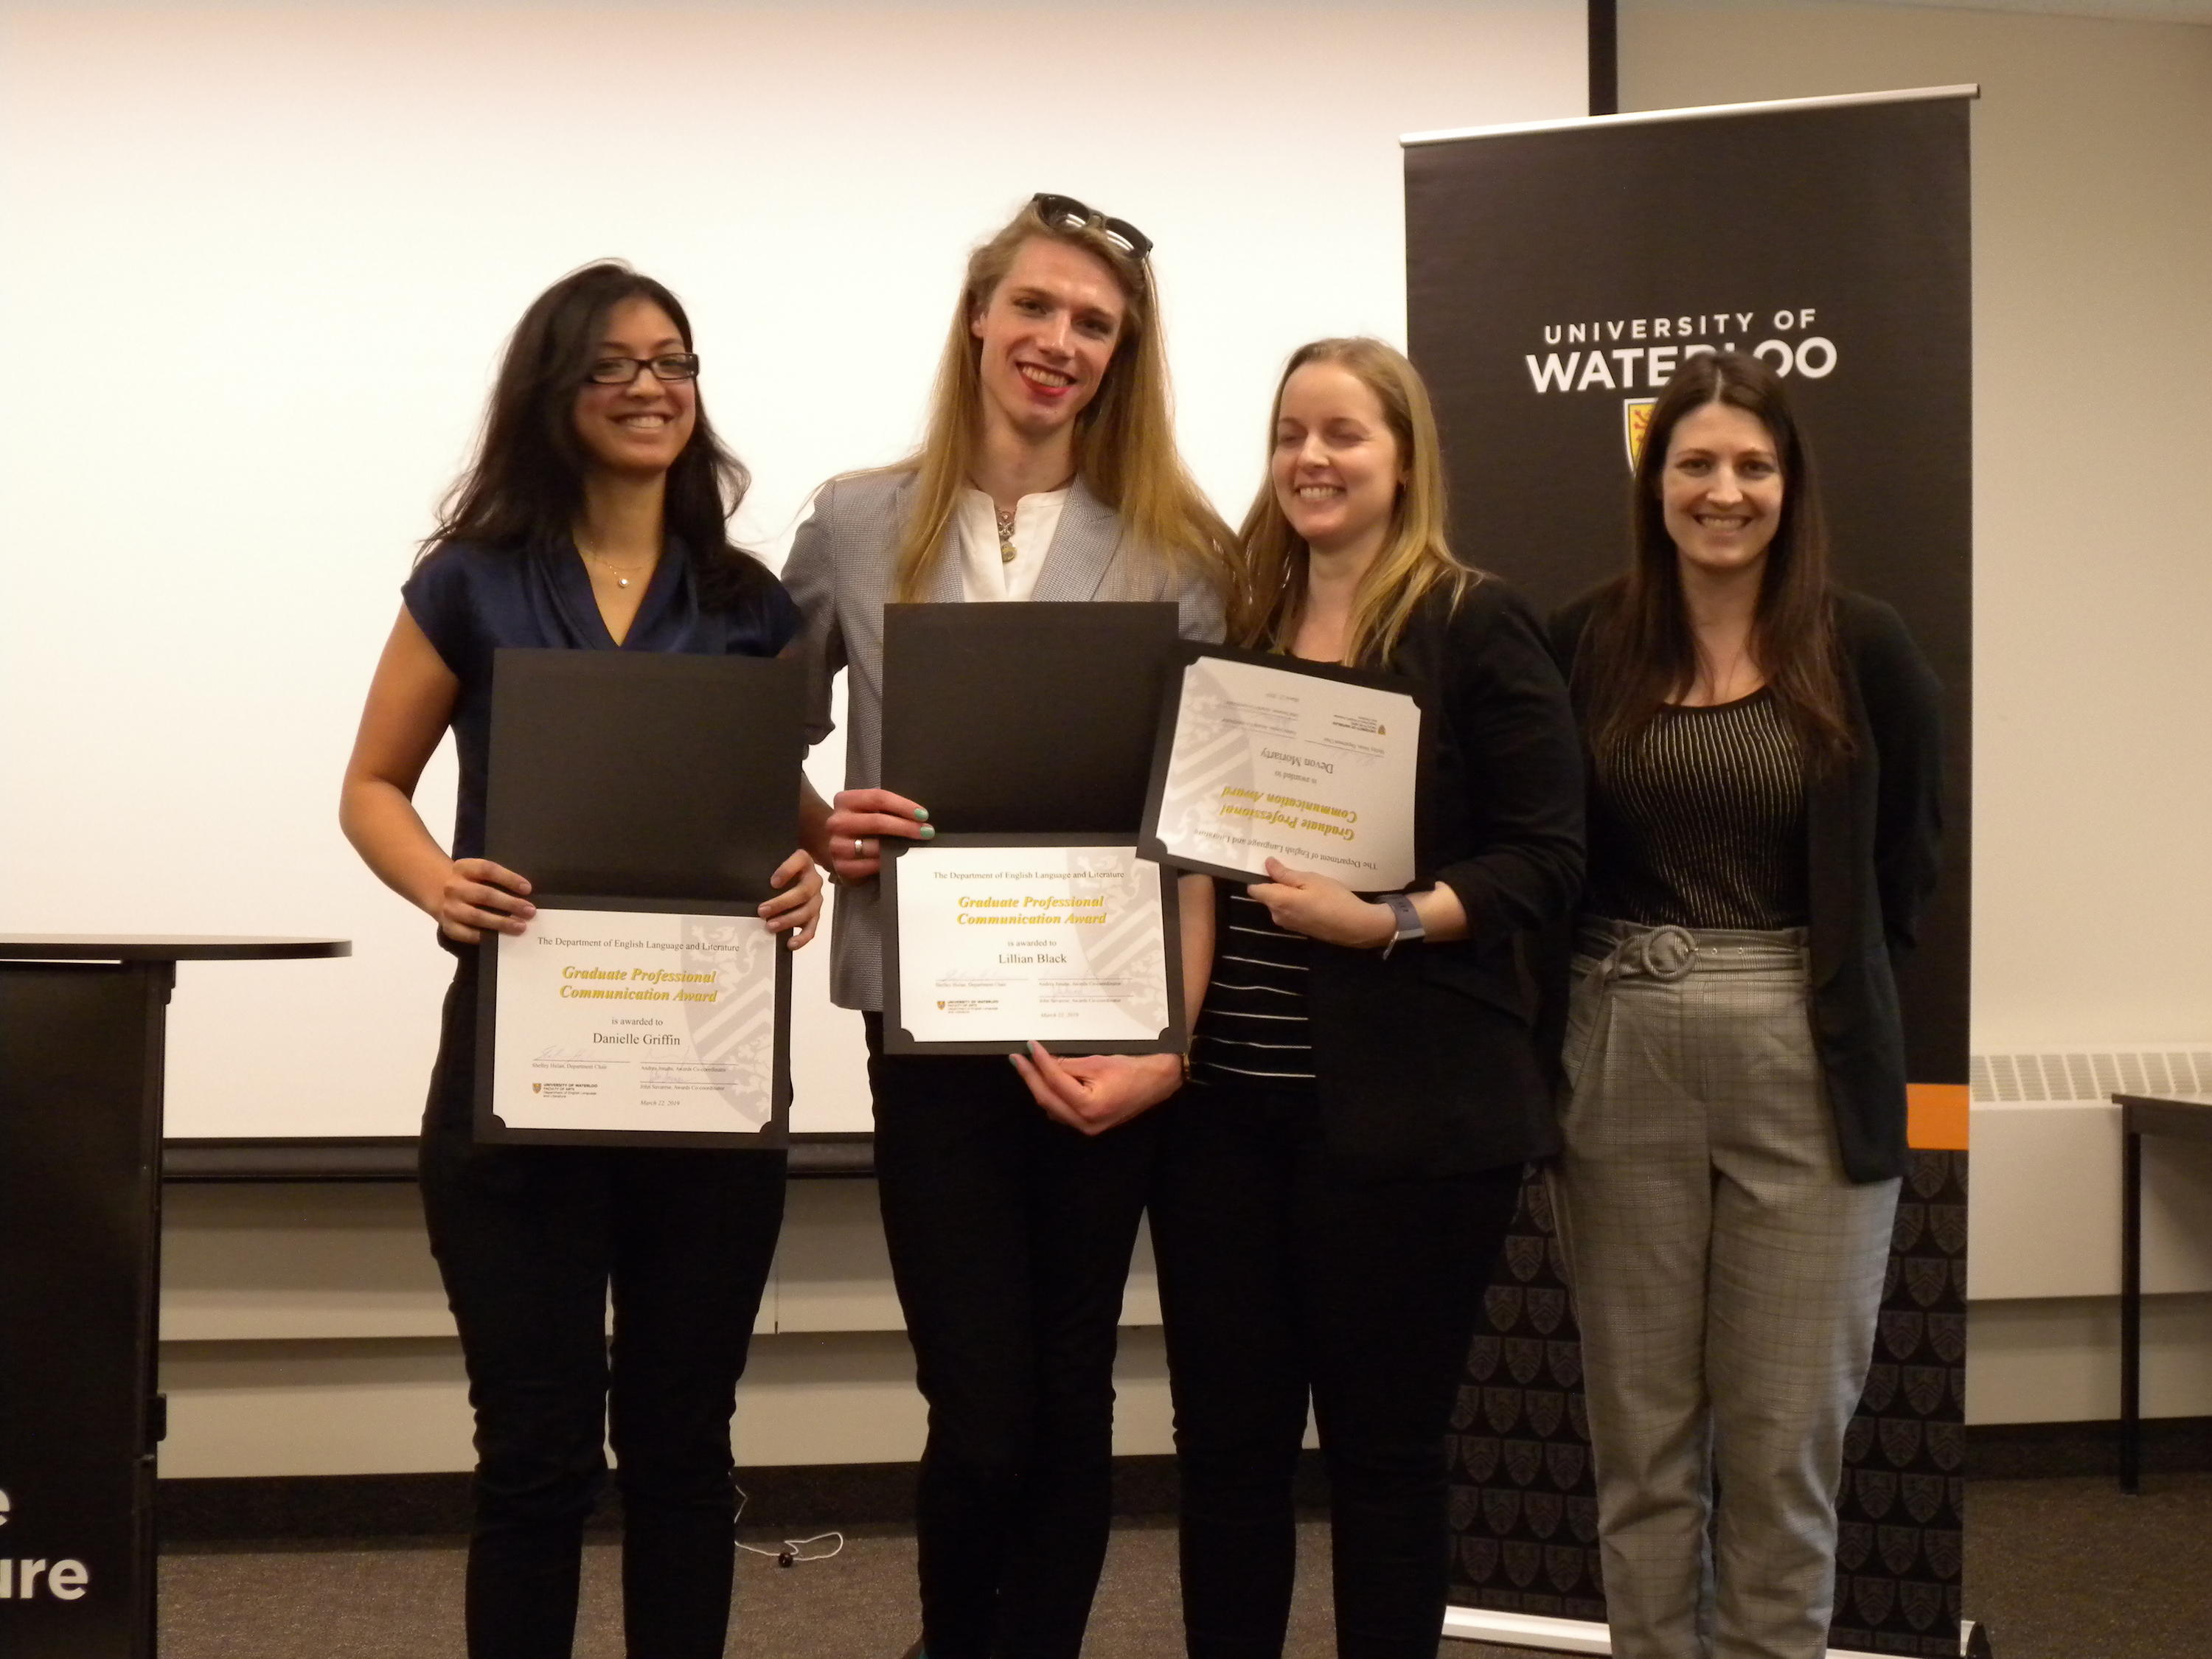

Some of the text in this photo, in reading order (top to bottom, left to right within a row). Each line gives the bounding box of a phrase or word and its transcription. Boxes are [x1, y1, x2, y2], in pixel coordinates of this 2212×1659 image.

[1544, 307, 1816, 344] UNIVERSITY OF
[1260, 748, 1334, 774] Devon Moriarty
[1283, 772, 1311, 783] awarded
[1221, 786, 1357, 824] Communication Award
[1220, 804, 1355, 841] Graduate Professional
[1194, 828, 1377, 871] The Department of English Language and Literature
[950, 872, 993, 880] Department
[1005, 872, 1033, 880] English
[1035, 872, 1071, 880] Language
[1073, 871, 1086, 879] and
[958, 895, 1104, 911] Graduate Professional
[956, 912, 1107, 925] Communication Award
[538, 936, 740, 951] The Department of English Language and Literature
[998, 953, 1068, 964] Lillian Black
[561, 966, 717, 984] Graduate Professional
[559, 985, 717, 1002] Communication Award
[620, 1018, 653, 1026] awarded
[593, 1032, 680, 1046] Danielle Griffin
